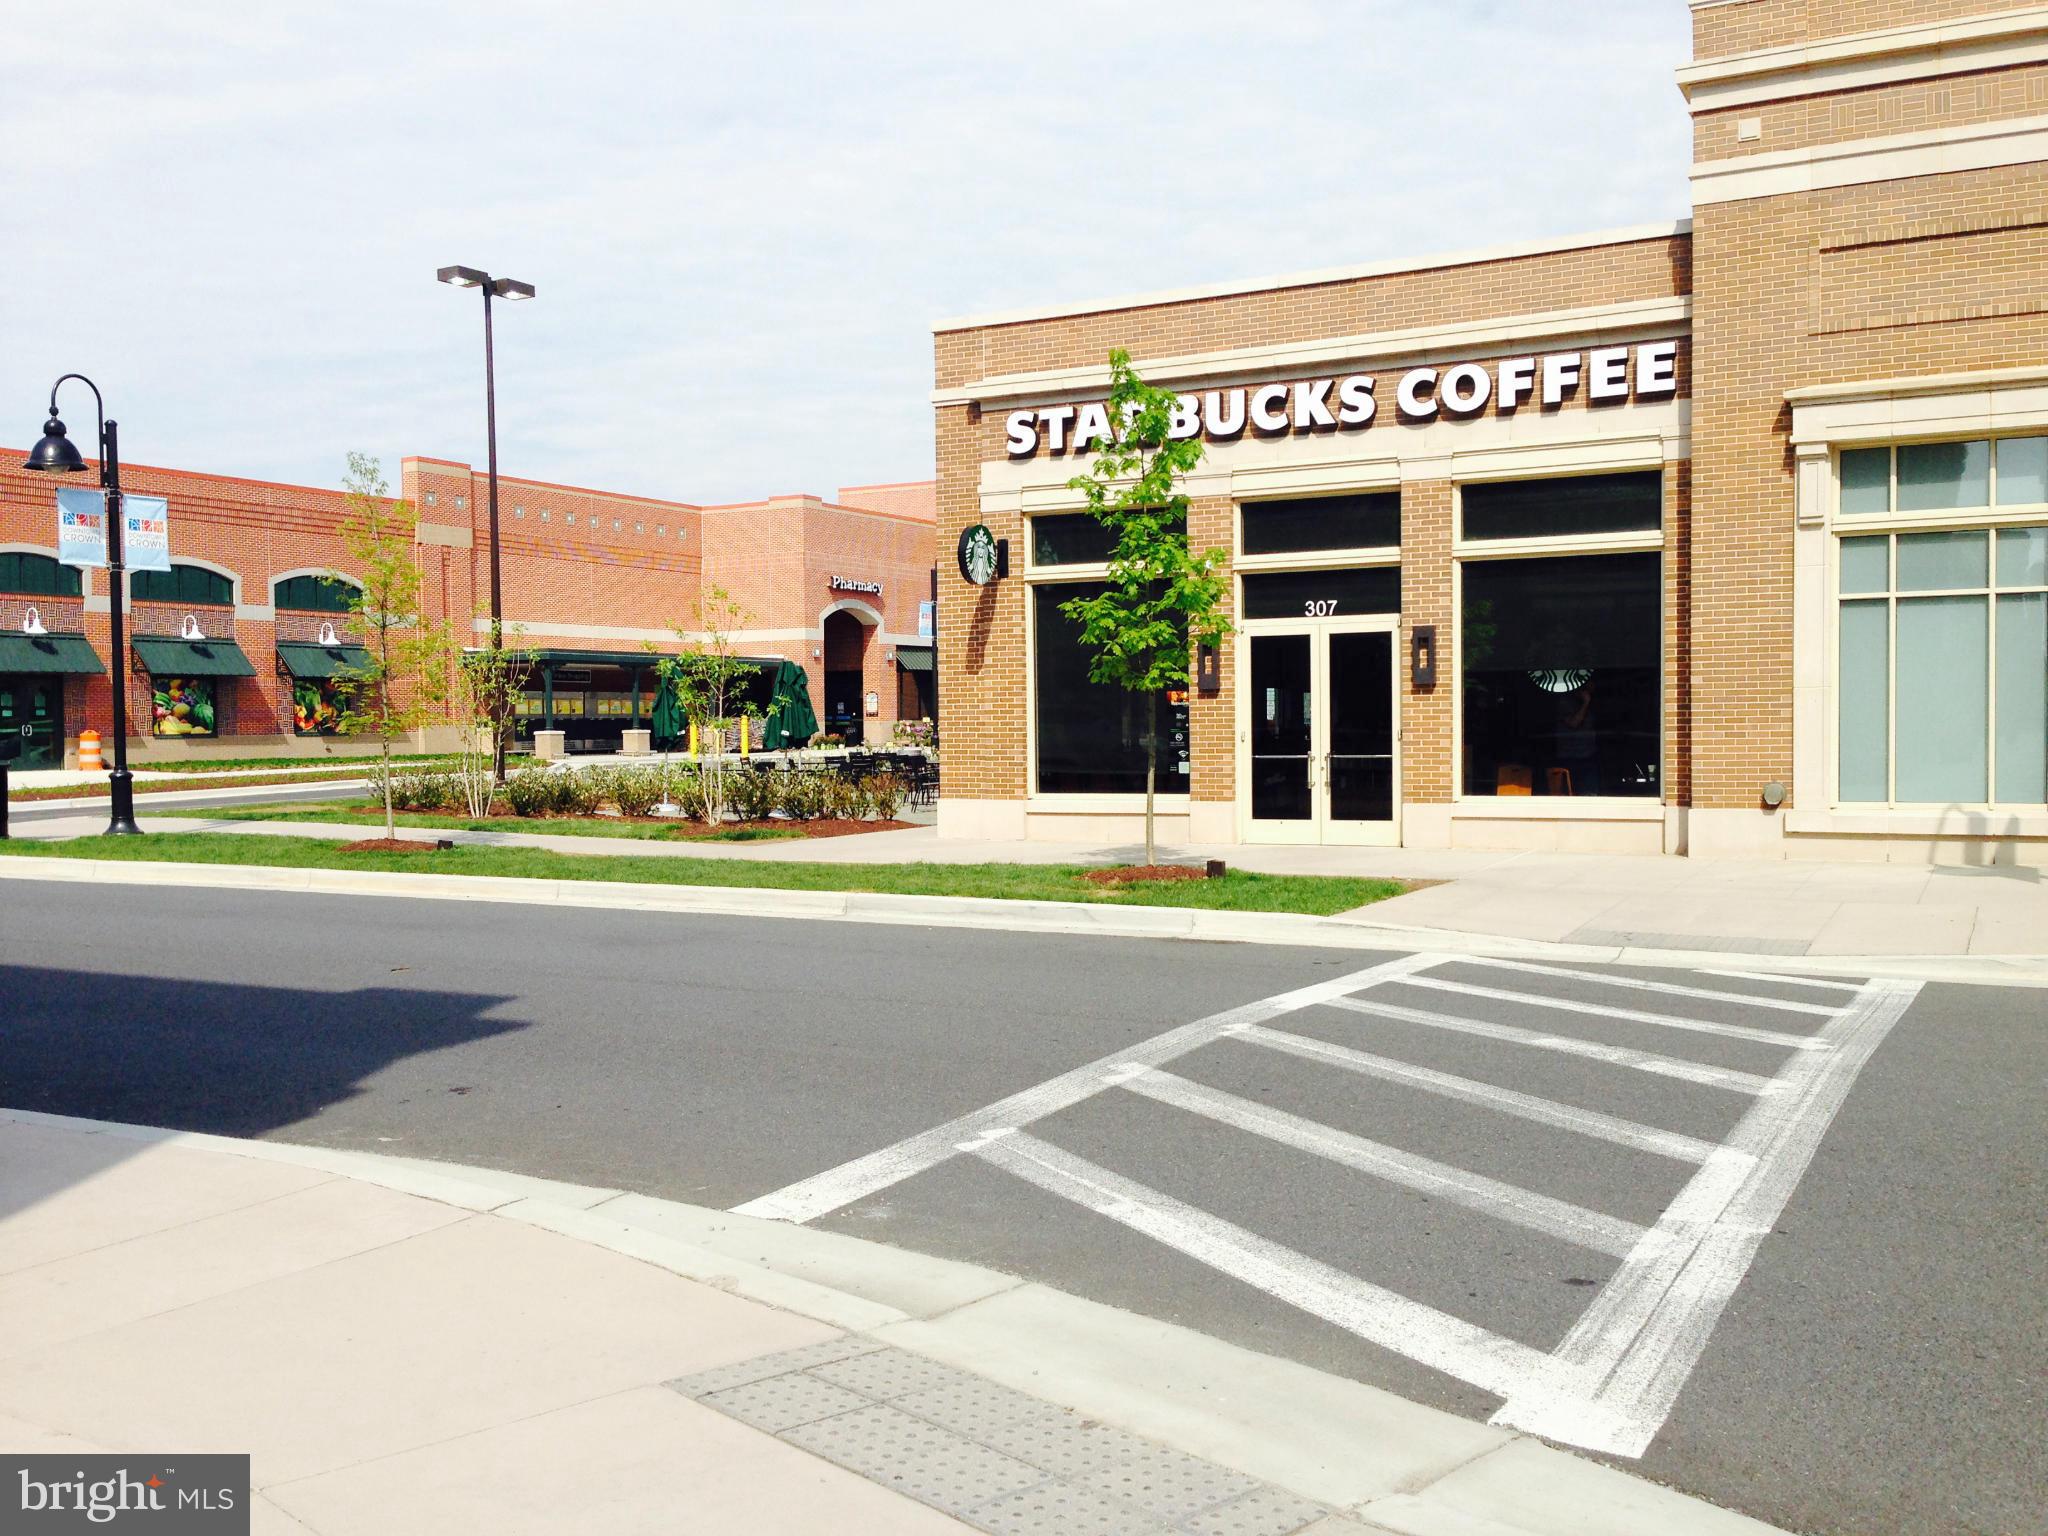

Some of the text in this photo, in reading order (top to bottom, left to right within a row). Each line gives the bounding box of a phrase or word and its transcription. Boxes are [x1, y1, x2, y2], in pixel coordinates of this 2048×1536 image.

[1396, 341, 1676, 417] COFFEE
[63, 534, 101, 544] CROWN
[128, 538, 166, 549] CROWN
[832, 575, 884, 596] Pharmacy
[1304, 599, 1338, 617] 307
